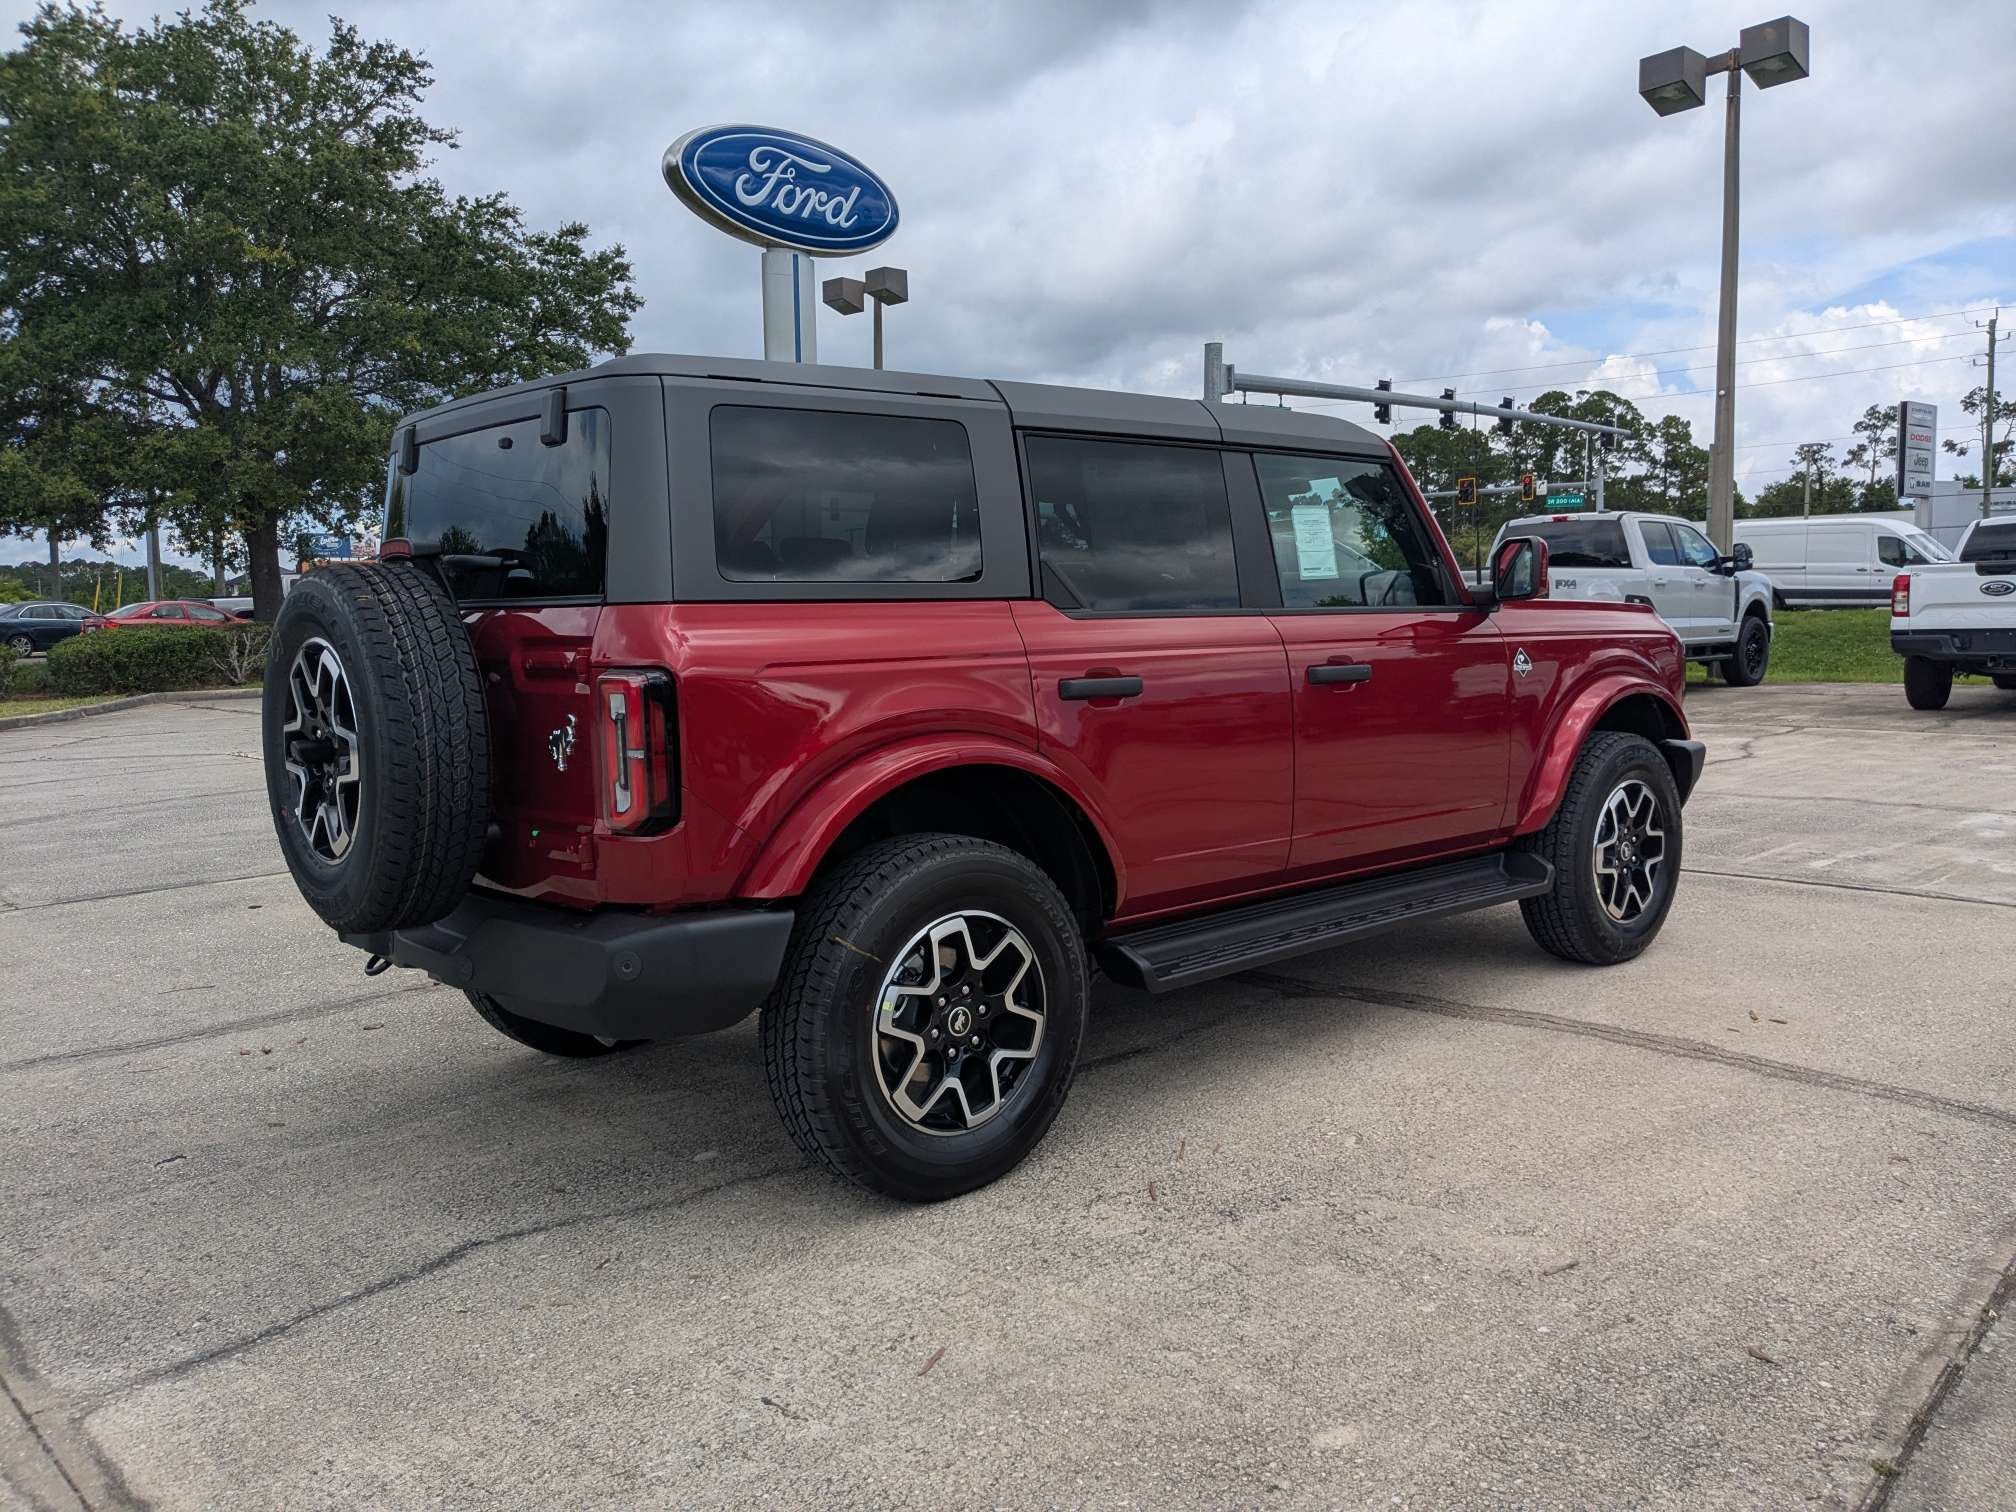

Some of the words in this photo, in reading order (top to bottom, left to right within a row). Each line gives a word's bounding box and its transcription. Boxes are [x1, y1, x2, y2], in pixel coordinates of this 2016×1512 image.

[735, 146, 861, 228] Ford
[1911, 433, 1932, 443] DODGE
[1914, 453, 1929, 471] Jeep
[1555, 579, 1577, 590] FX4
